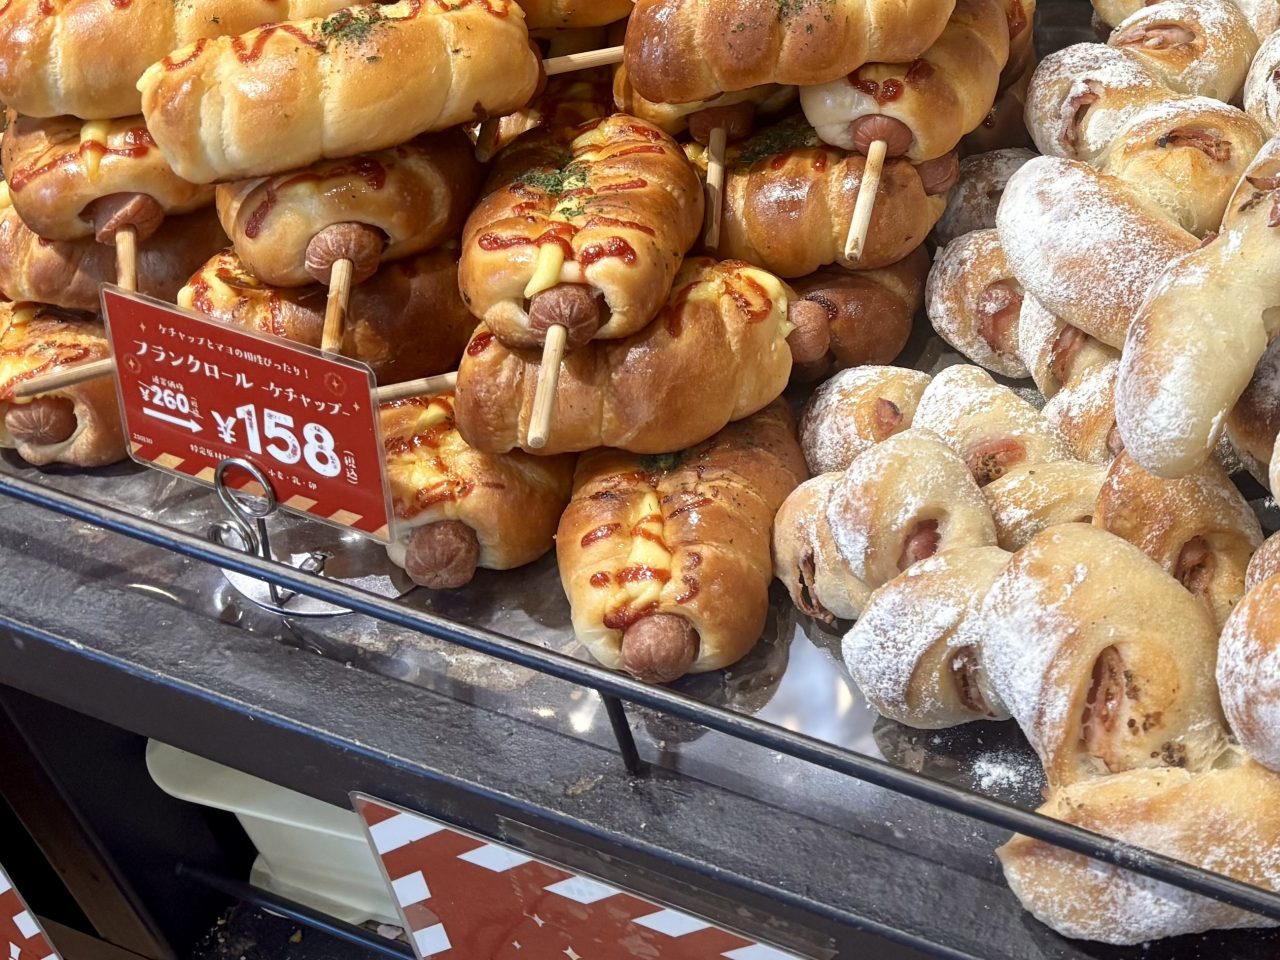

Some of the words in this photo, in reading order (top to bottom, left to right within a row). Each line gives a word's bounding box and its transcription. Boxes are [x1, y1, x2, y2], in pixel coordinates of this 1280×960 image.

[133, 340, 254, 389] フランクロール
[139, 385, 191, 415] ¥260
[211, 404, 342, 478] ¥158
